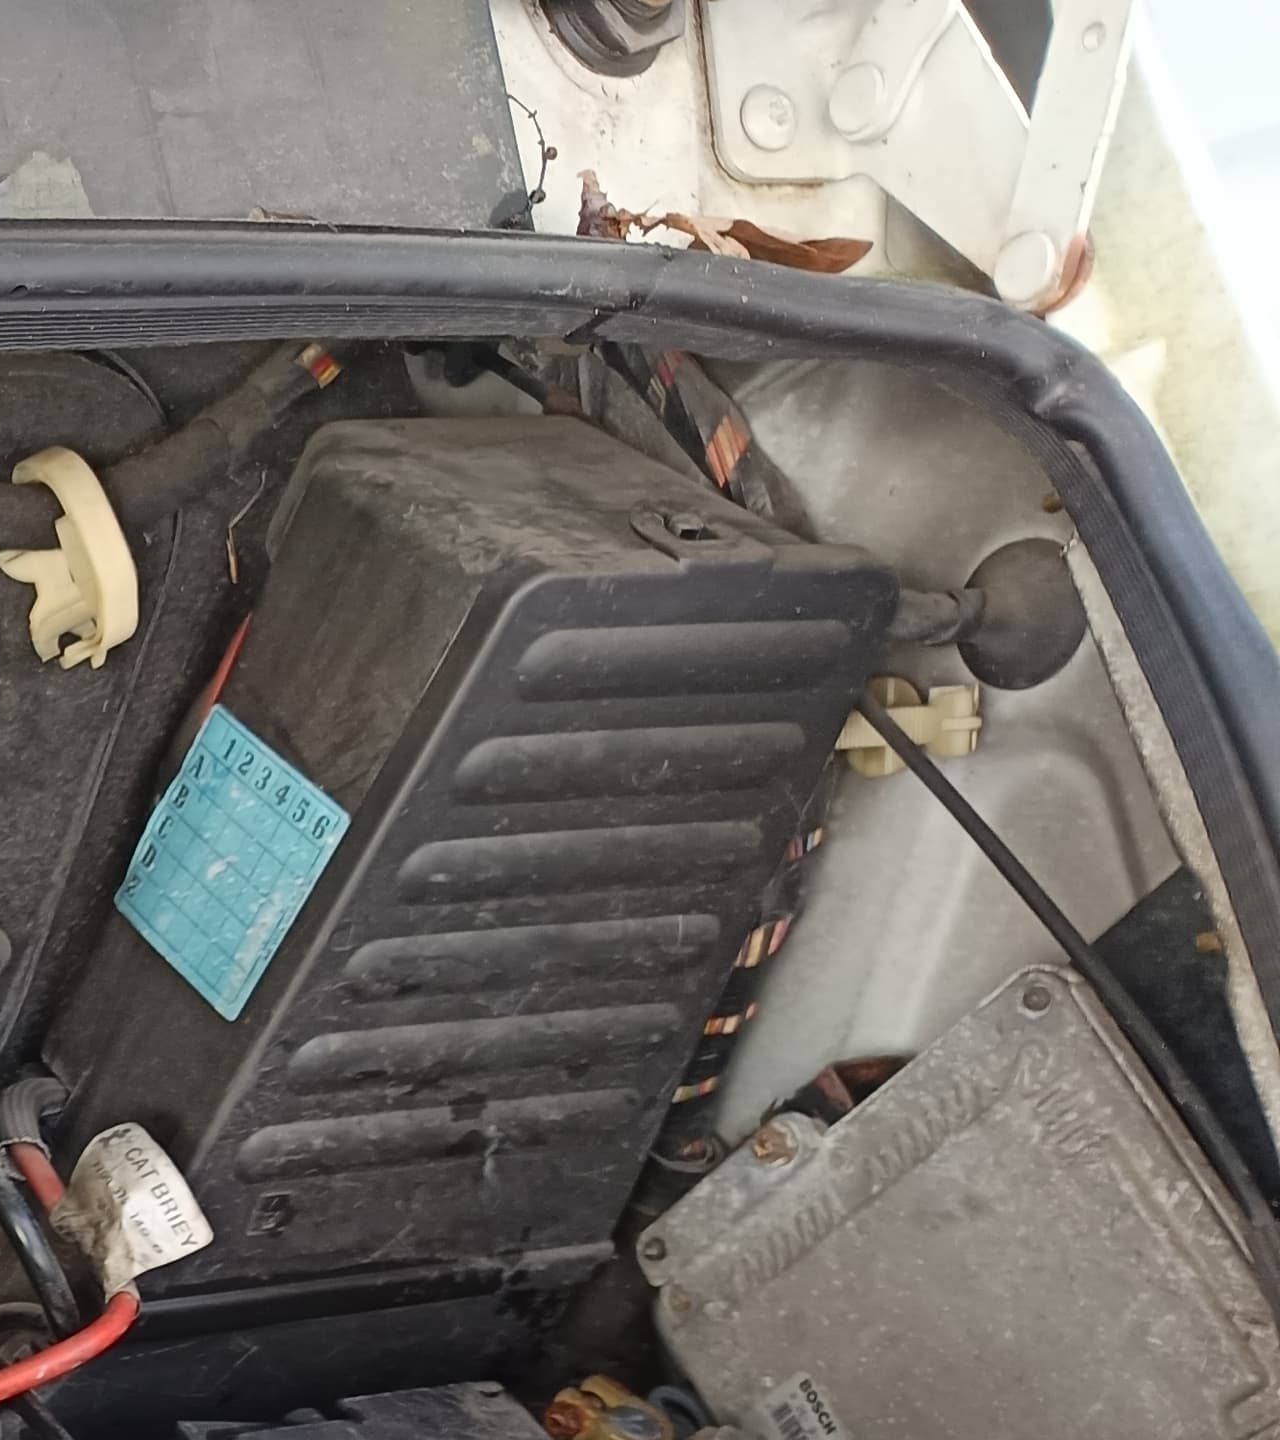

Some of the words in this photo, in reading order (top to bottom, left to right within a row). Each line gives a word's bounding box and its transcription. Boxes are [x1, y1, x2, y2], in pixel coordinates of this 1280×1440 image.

[189, 754, 205, 779] A
[172, 784, 189, 809] B
[221, 738, 237, 760] 1
[237, 751, 255, 775] 2
[255, 766, 273, 790] 3
[275, 784, 291, 807] 4
[292, 799, 311, 823] 5
[311, 815, 330, 840] 6
[157, 815, 174, 839] C
[140, 845, 157, 871] D
[125, 1147, 160, 1180] CAT
[150, 1182, 200, 1248] BRIEY
[799, 1378, 837, 1435] BOSCH
